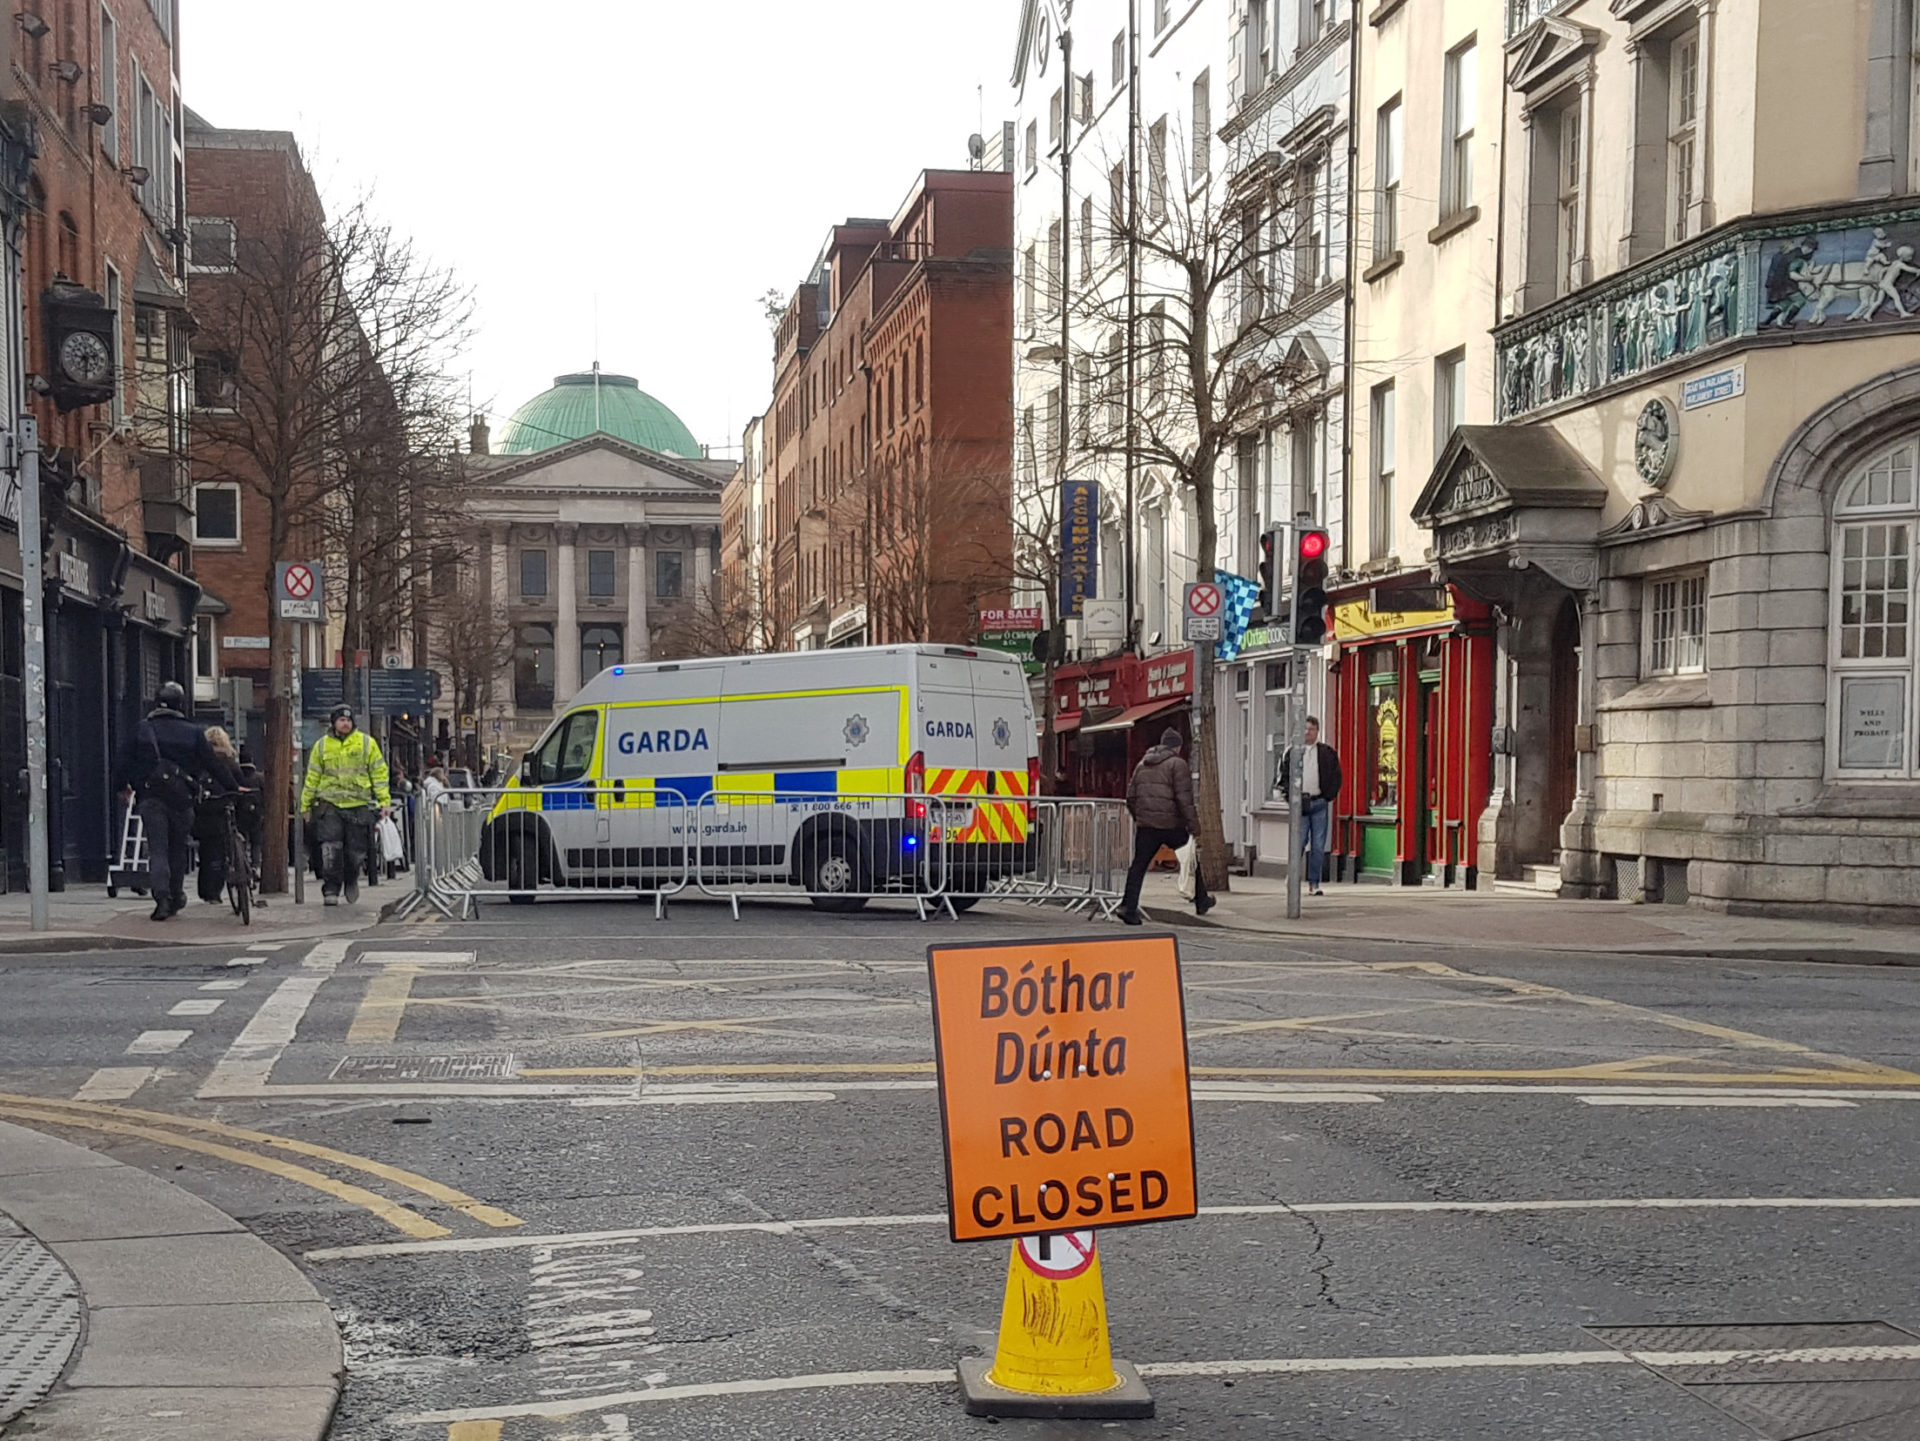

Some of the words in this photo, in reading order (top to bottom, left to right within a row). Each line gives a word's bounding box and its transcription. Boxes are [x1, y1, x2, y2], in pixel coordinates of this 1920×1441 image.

[1736, 373, 1742, 387] 2
[981, 609, 1004, 620] FOR
[1007, 608, 1039, 619] SALE
[618, 728, 709, 755] GARDA
[925, 720, 974, 739] GARDA
[980, 959, 1135, 1019] Bóthar
[994, 1026, 1128, 1085] Dúnta
[1000, 1107, 1135, 1158] ROAD
[972, 1170, 1169, 1228] CLOSED
